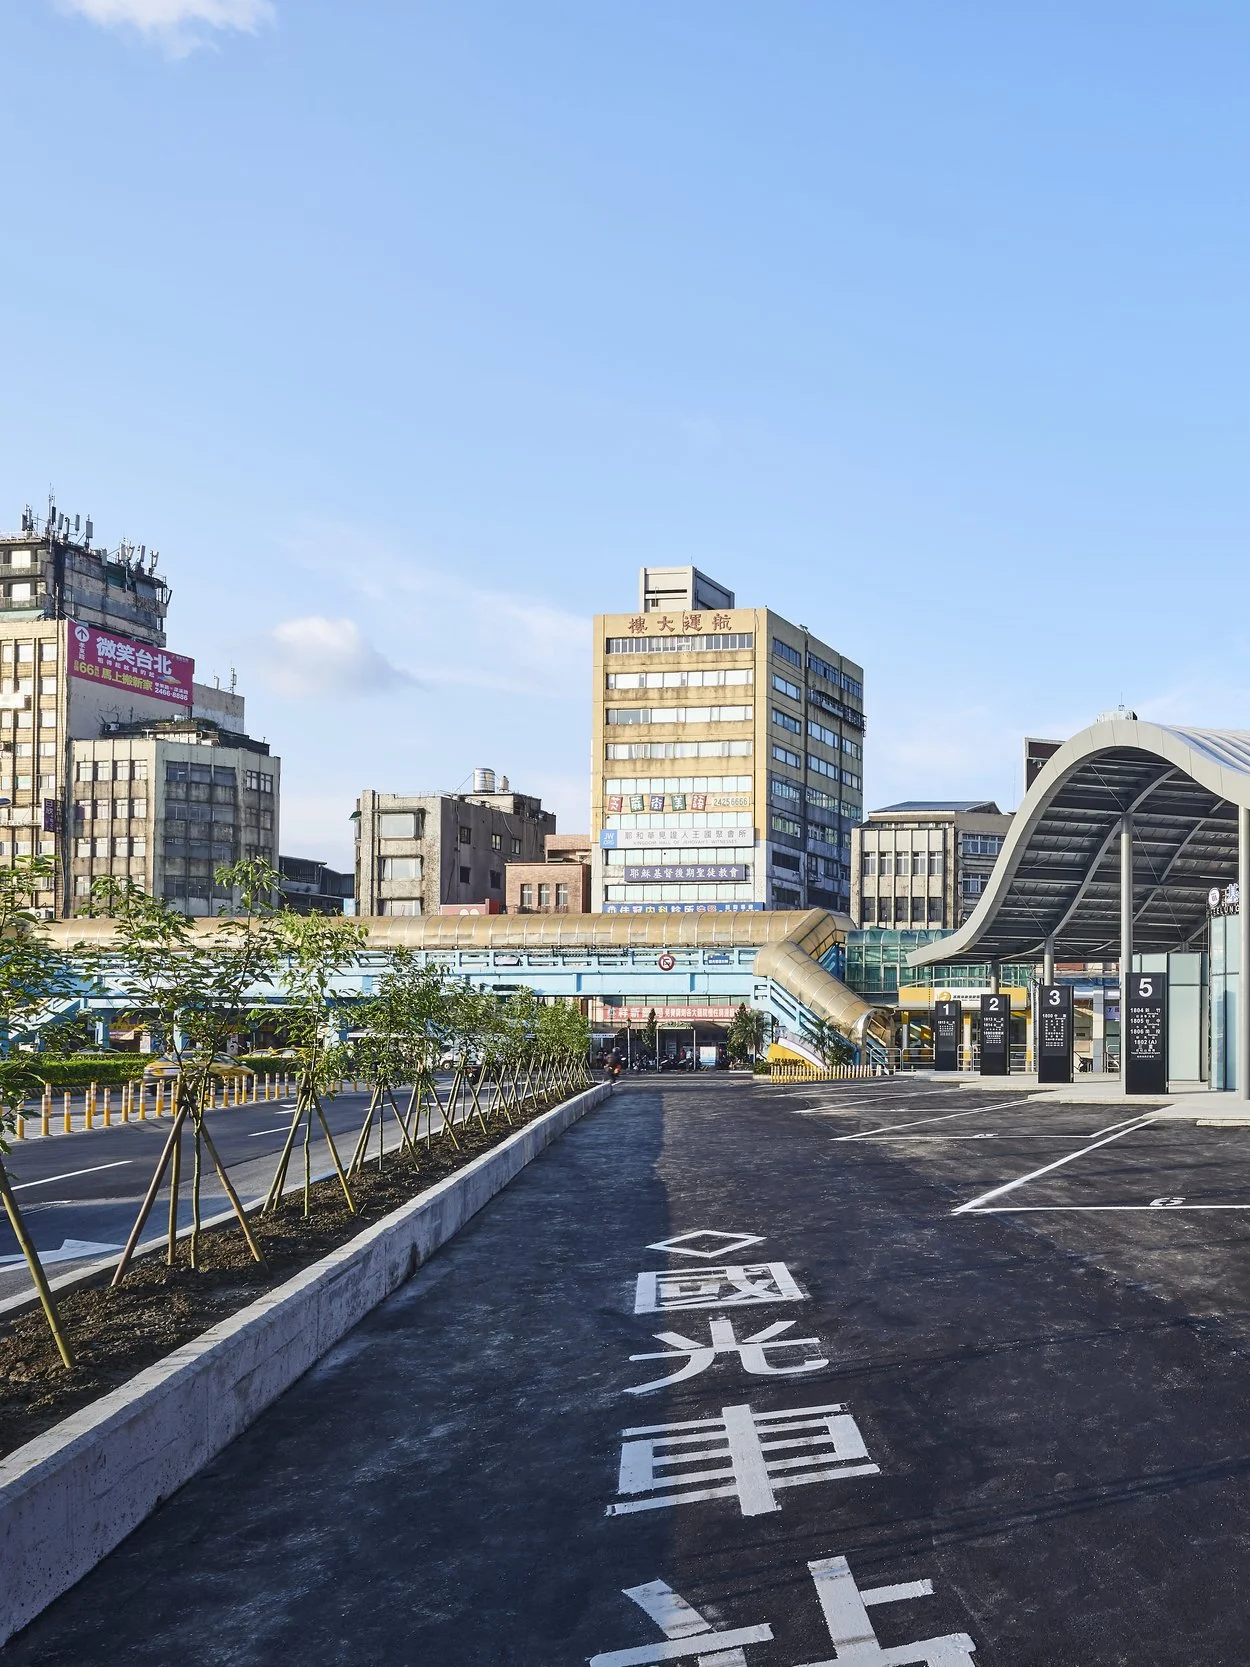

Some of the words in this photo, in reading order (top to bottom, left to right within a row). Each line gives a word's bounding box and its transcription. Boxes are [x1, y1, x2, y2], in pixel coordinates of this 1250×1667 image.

[96, 636, 172, 675] 微笑台北
[630, 866, 739, 879] 耶穌基督後期聖徒教會
[1138, 978, 1153, 997] 5
[989, 997, 999, 1010] 2
[1049, 990, 1060, 1005] 3
[943, 1004, 949, 1015] 1
